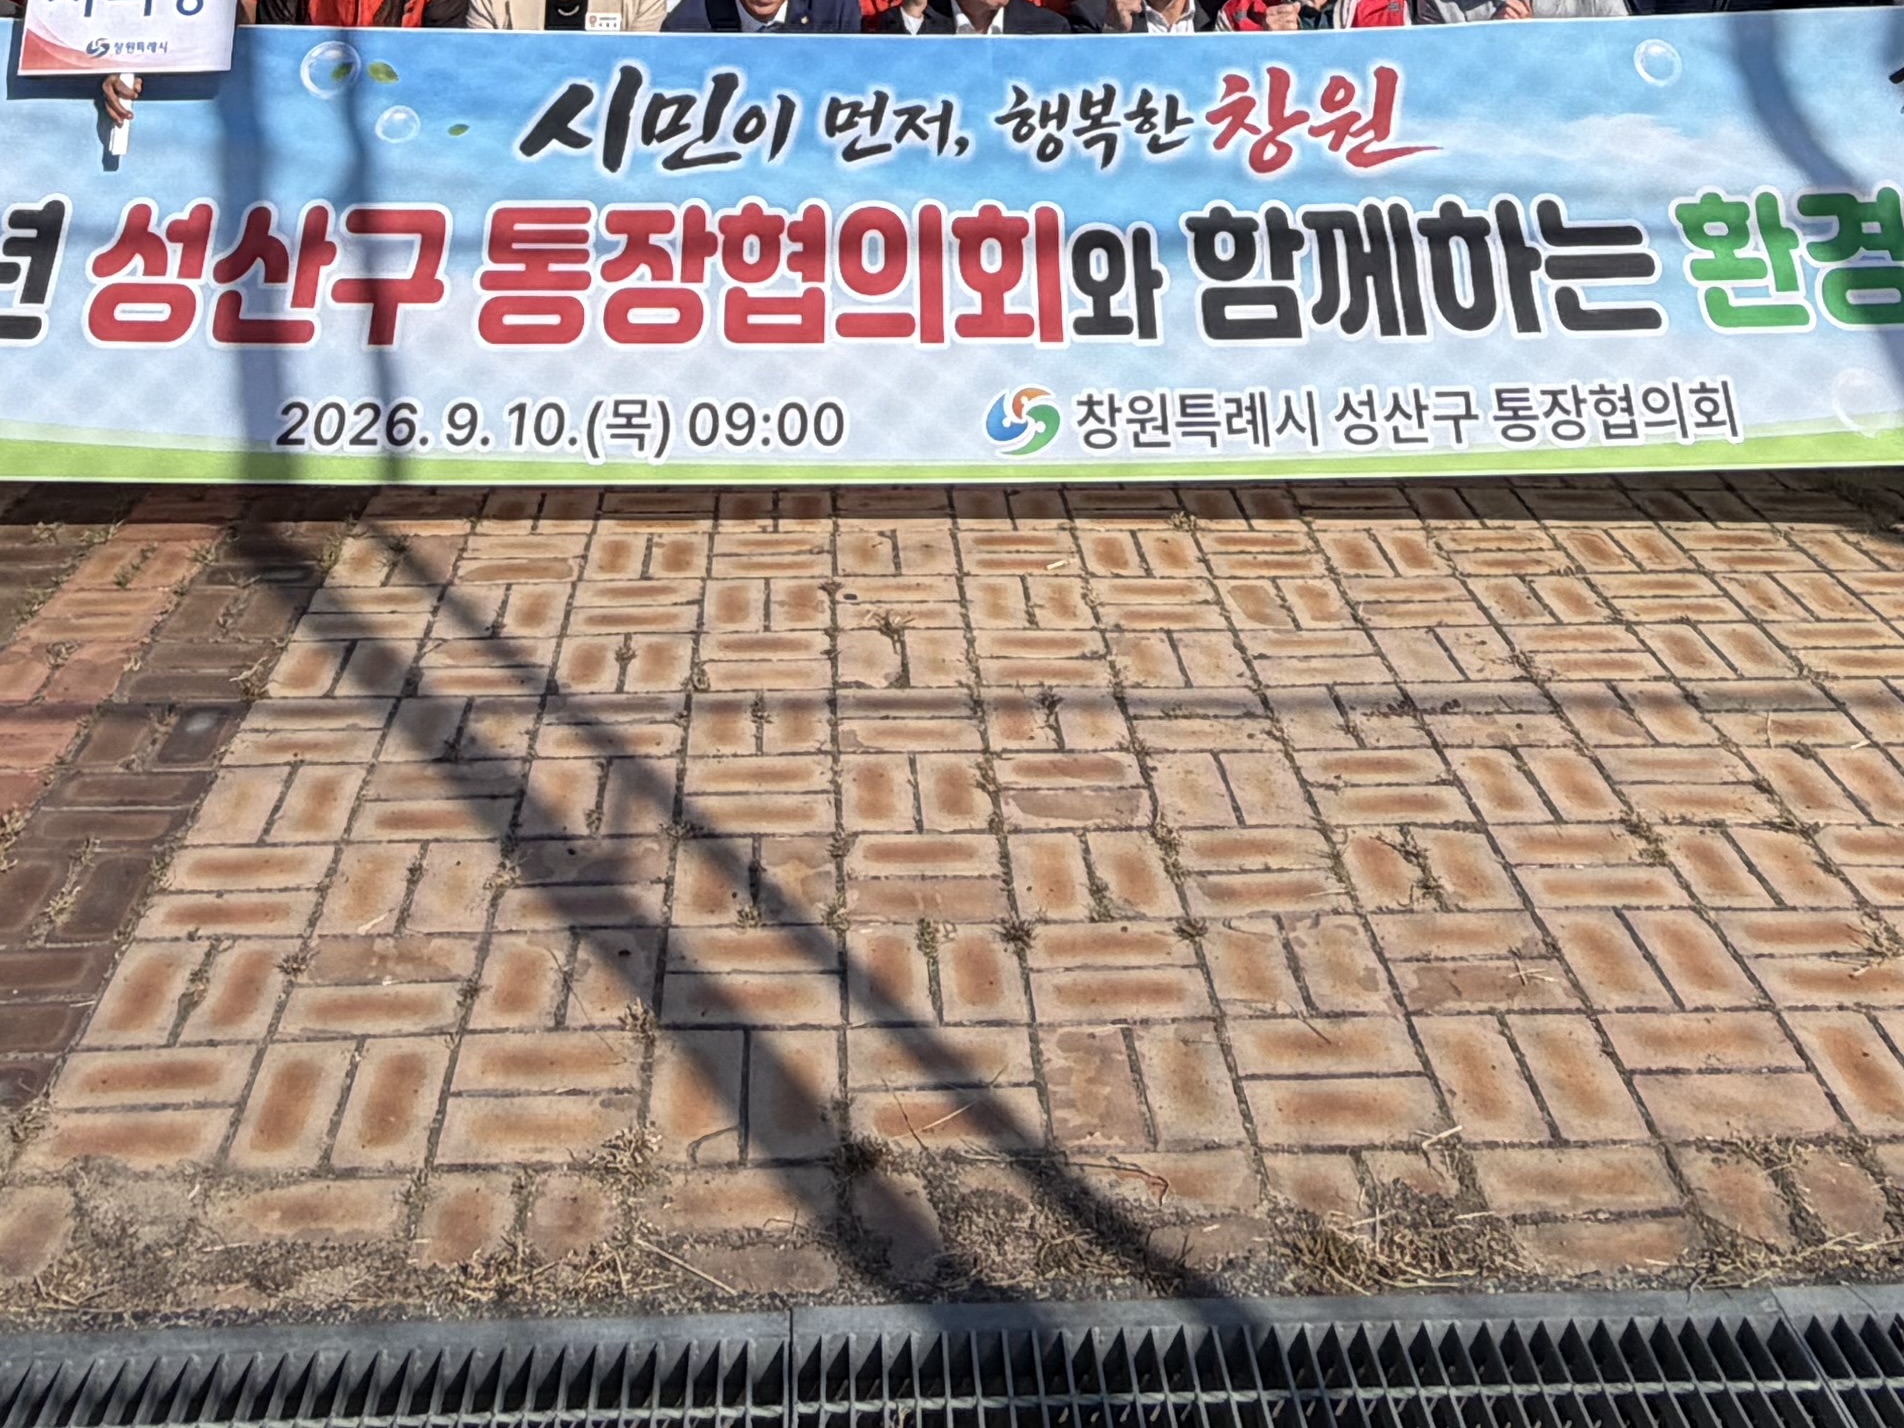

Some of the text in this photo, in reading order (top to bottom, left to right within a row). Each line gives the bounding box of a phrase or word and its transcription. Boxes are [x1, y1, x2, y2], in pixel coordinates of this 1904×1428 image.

[519, 66, 1444, 174] 시민이 먼저, 행복한 창원
[88, 204, 446, 345] 성산구
[478, 204, 1164, 344] 통장협의회와
[1186, 199, 1662, 340] 함께하는
[276, 399, 845, 459] 2026. 9. 10.(목) 09:00
[1075, 380, 1739, 449] 창원특례시 성산구 통장협의회
